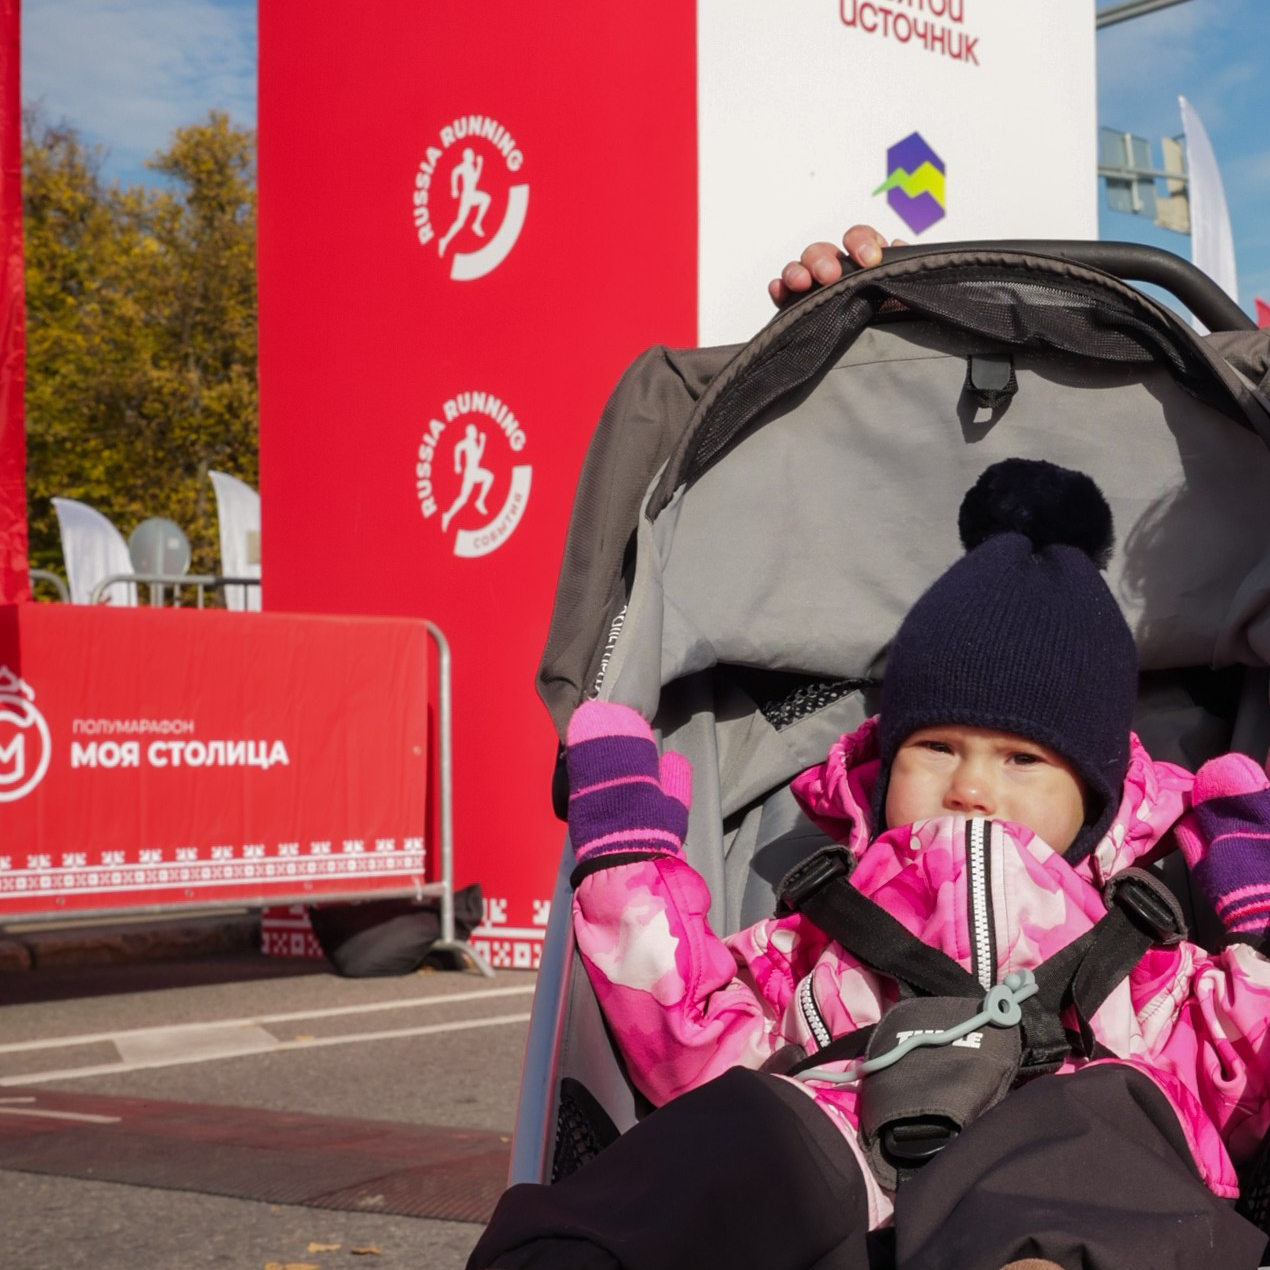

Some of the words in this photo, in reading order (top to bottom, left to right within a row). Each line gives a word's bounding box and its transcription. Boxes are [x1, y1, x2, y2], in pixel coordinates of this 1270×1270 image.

[414, 146, 442, 245] RUSSIA
[439, 115, 524, 172] RUNNING
[416, 419, 446, 518] RUSSIA
[443, 391, 527, 451] RUNNING
[71, 741, 139, 768] МОЯ
[148, 740, 289, 770] СТОЛИЦА
[72, 718, 195, 735] ПОЛУМАРАФОН
